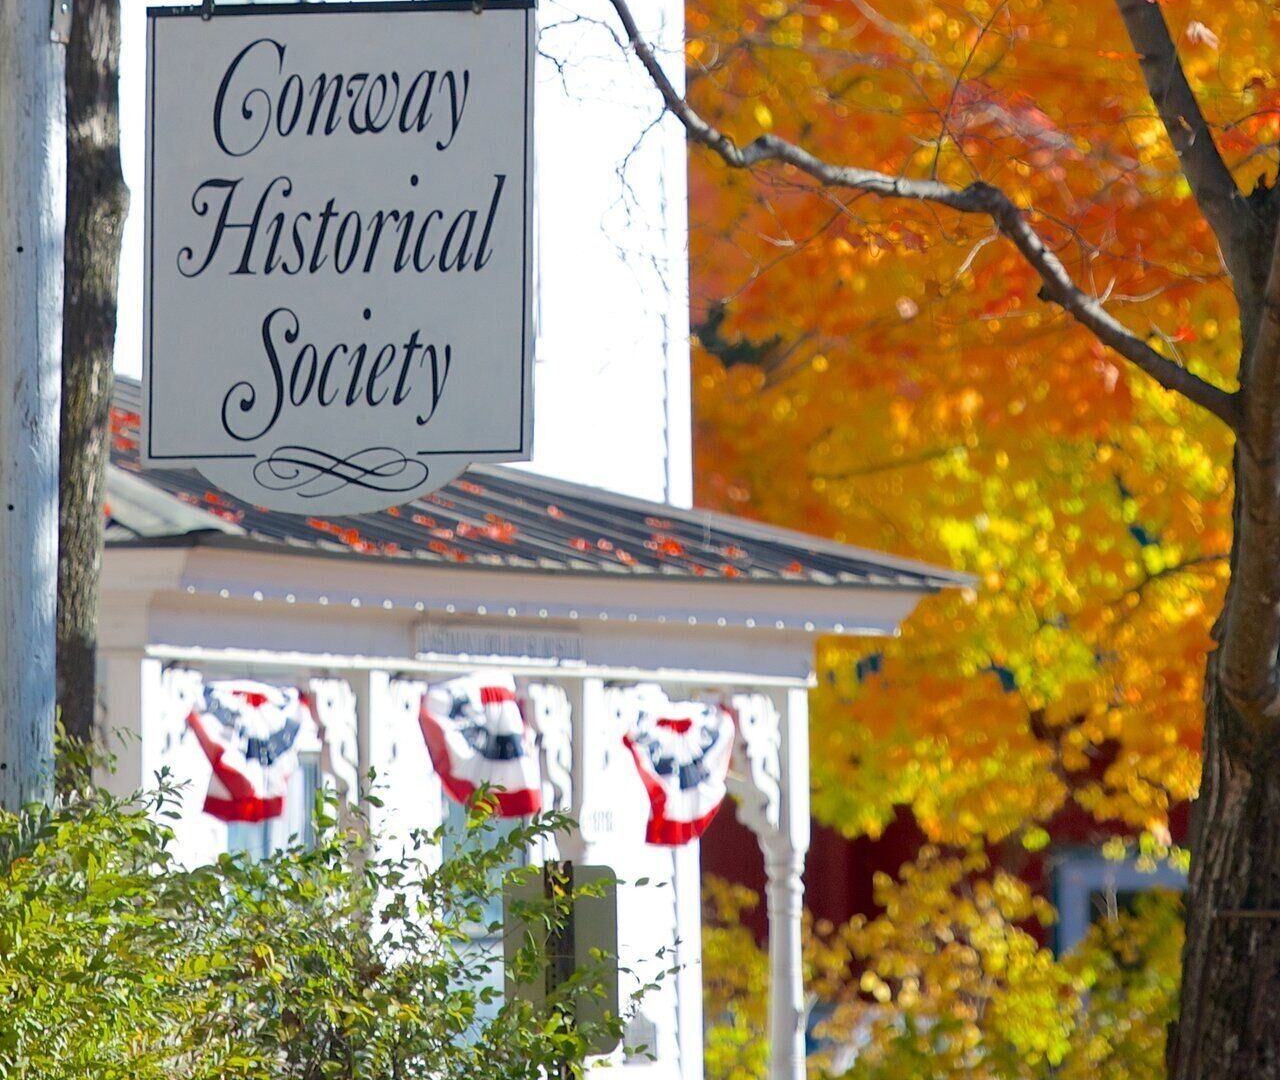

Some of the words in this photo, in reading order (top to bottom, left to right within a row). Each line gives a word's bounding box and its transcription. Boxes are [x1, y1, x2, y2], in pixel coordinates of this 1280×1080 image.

[212, 37, 471, 157] Conway
[176, 173, 507, 278] Historical
[220, 306, 452, 441] Society
